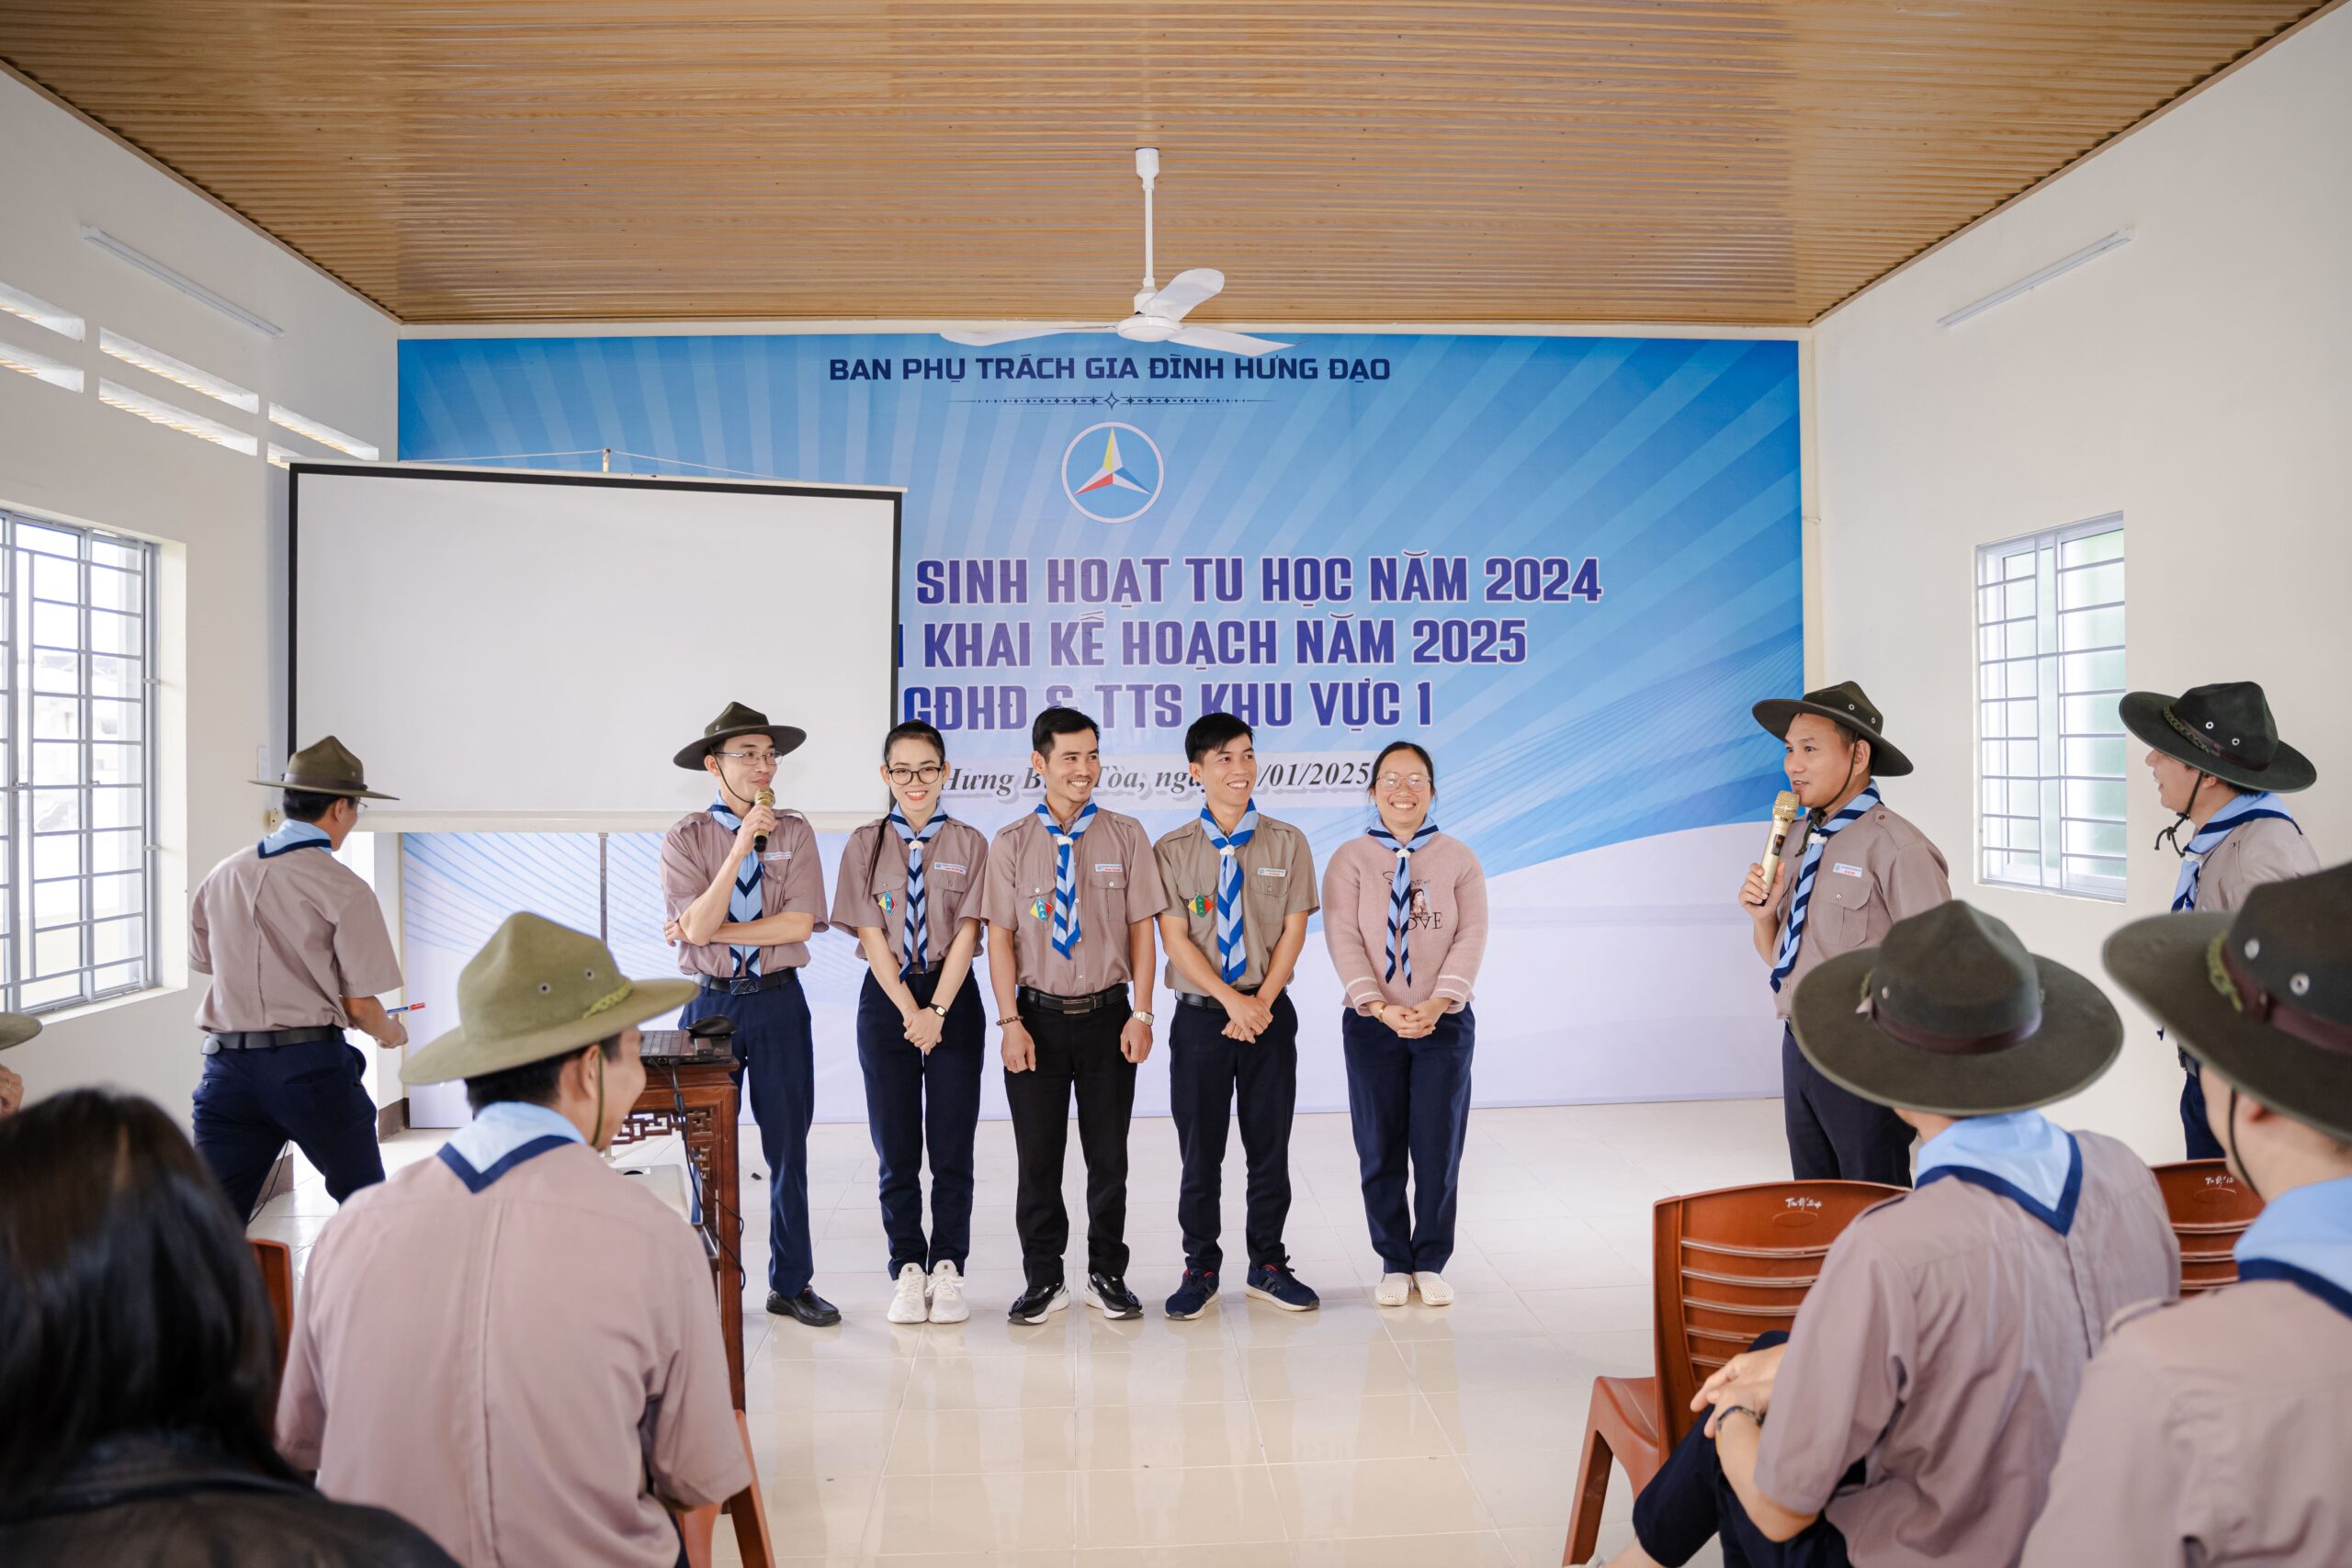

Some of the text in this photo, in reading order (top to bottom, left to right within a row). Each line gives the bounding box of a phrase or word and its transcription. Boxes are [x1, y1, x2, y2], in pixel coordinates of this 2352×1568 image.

[830, 352, 1391, 383] BAN PHỤ TRÁCH GIA ĐÌNH HƯNG ĐẠO
[916, 551, 1602, 608] SINH HOẠT TU HỌC NĂM 2024
[924, 622, 1030, 668] KHAI
[1050, 611, 1105, 666] KẾ
[1122, 620, 1277, 671] HOẠCH
[1296, 614, 1395, 664] NĂM
[1413, 620, 1526, 663] 2025
[1094, 683, 1182, 728] TTS
[1201, 682, 1292, 727] KHU
[1309, 677, 1400, 731] VỰC
[1417, 682, 1431, 726] 1
[942, 768, 1014, 796] Hưng
[1257, 761, 1371, 787] /01/2025
